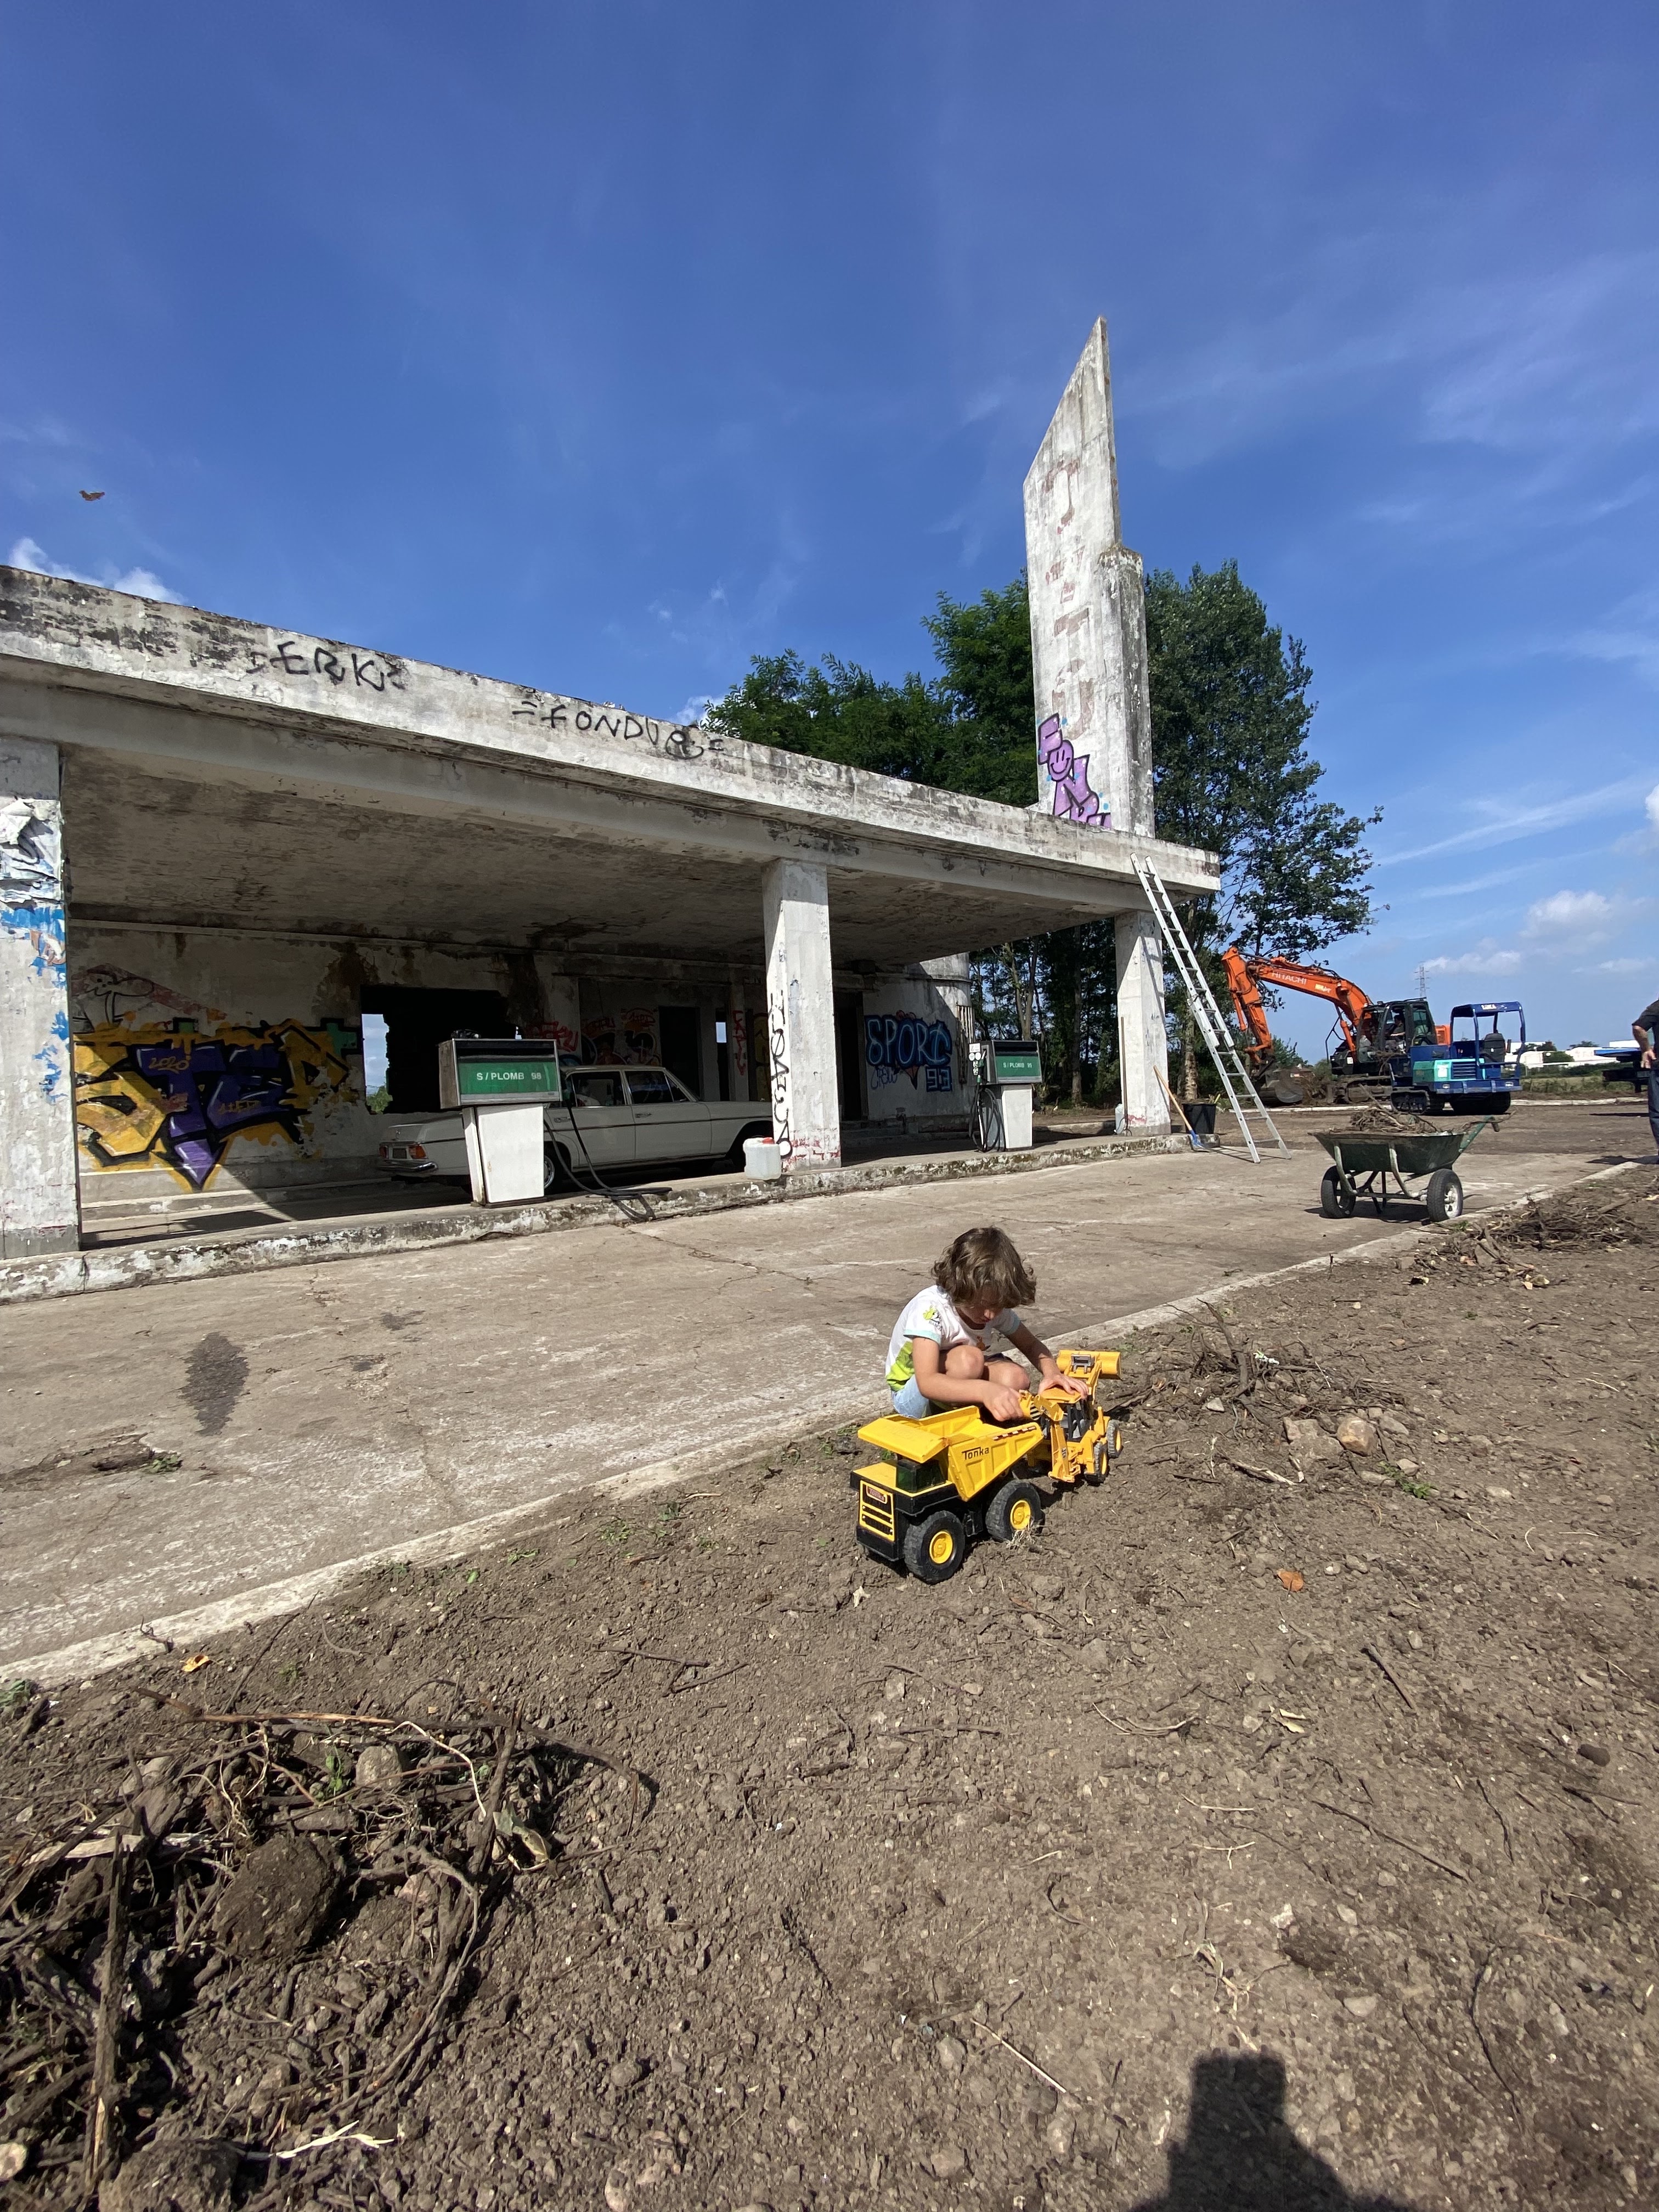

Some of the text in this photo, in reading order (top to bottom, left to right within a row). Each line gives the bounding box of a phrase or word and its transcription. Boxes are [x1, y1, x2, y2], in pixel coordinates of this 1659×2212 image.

[1272, 972, 1307, 985] HITACHI
[531, 1072, 542, 1080] 98
[962, 1446, 990, 1460] Tonka
